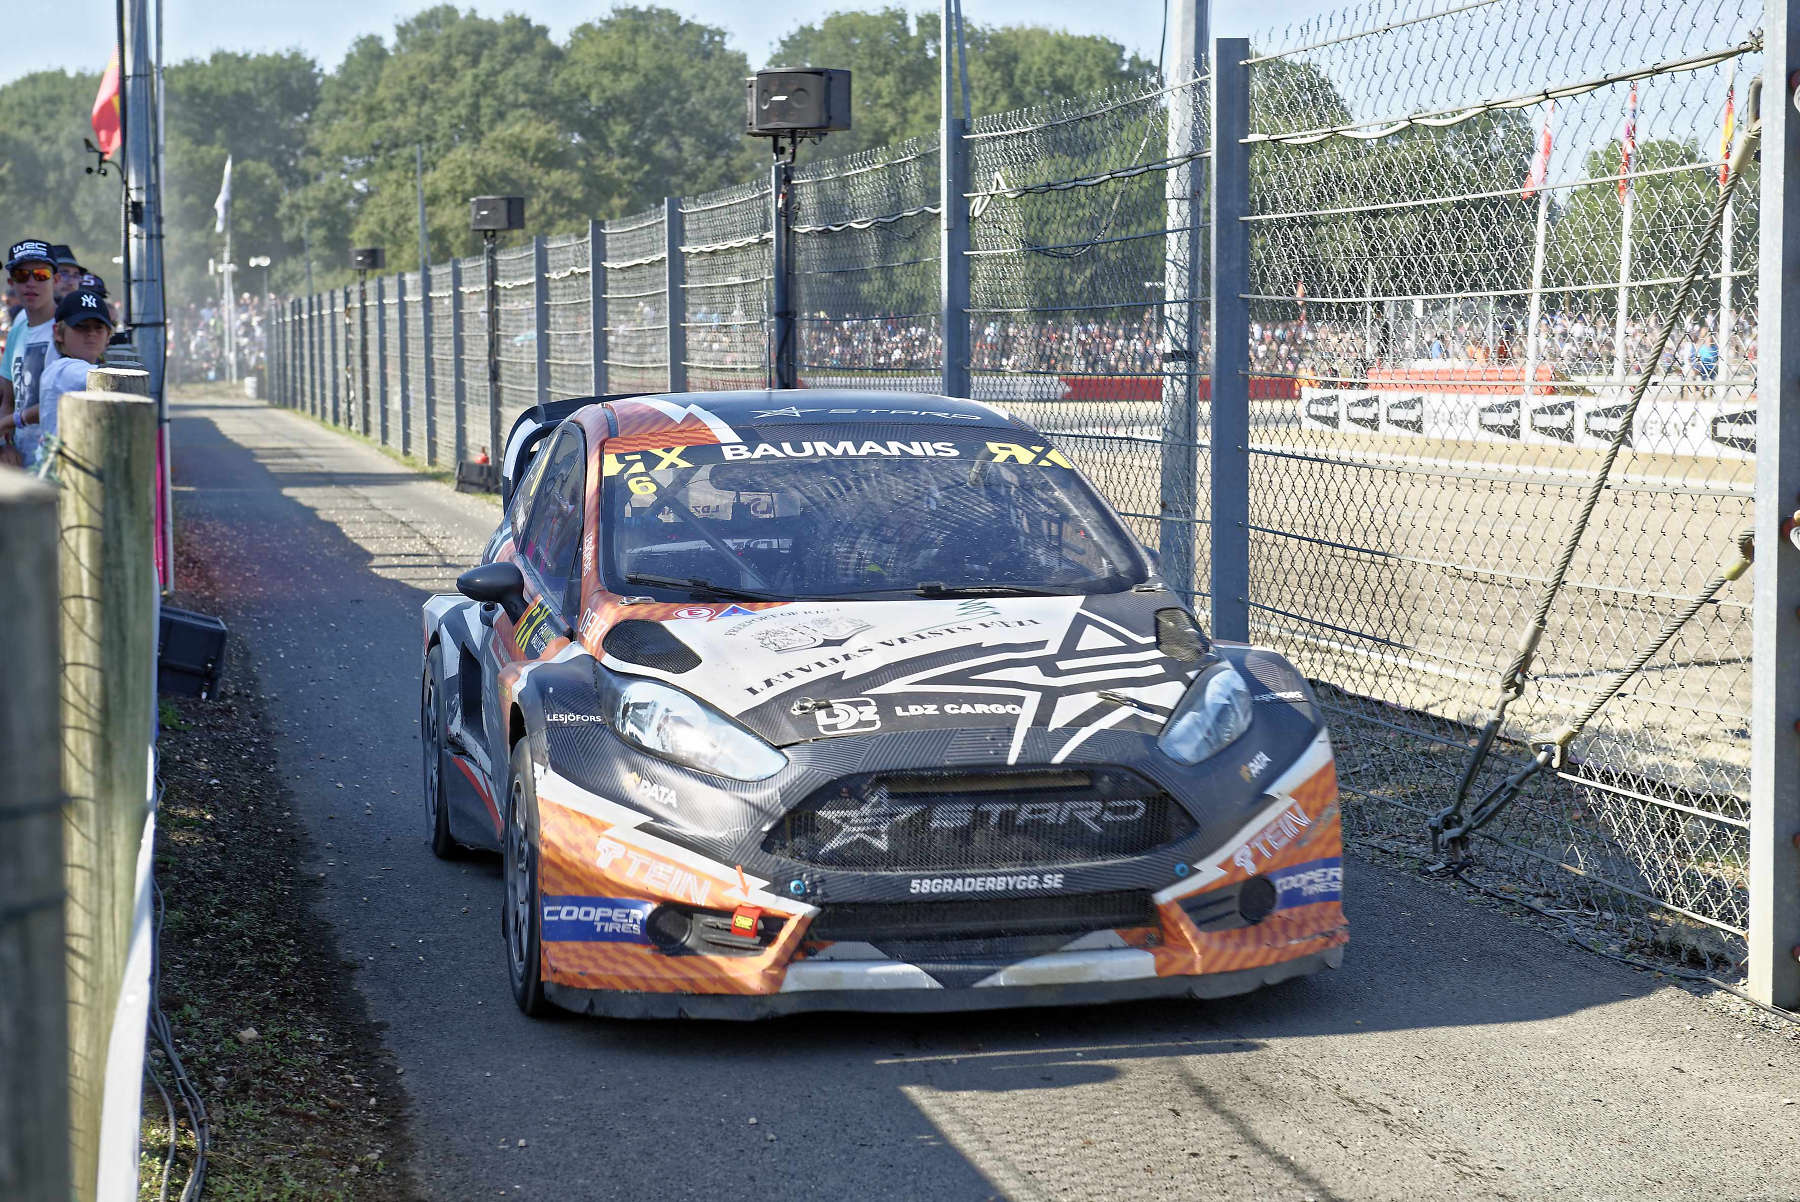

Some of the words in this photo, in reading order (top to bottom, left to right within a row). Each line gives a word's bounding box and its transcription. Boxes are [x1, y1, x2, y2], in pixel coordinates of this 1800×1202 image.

[13, 242, 47, 253] WRC
[80, 294, 97, 308] NY
[720, 441, 960, 461] BAUMANIS
[627, 476, 658, 496] 6
[744, 645, 874, 697] LATVIJAS
[879, 623, 973, 648] VALSTS
[546, 712, 602, 724] LESJÖFORS
[894, 703, 940, 717] LDZ
[944, 702, 1023, 716] CARGO
[620, 849, 712, 906] TEIN
[909, 874, 1065, 894] 58GRADERBYGG.SE
[543, 905, 645, 924] COOPER
[593, 921, 641, 935] TIRES
